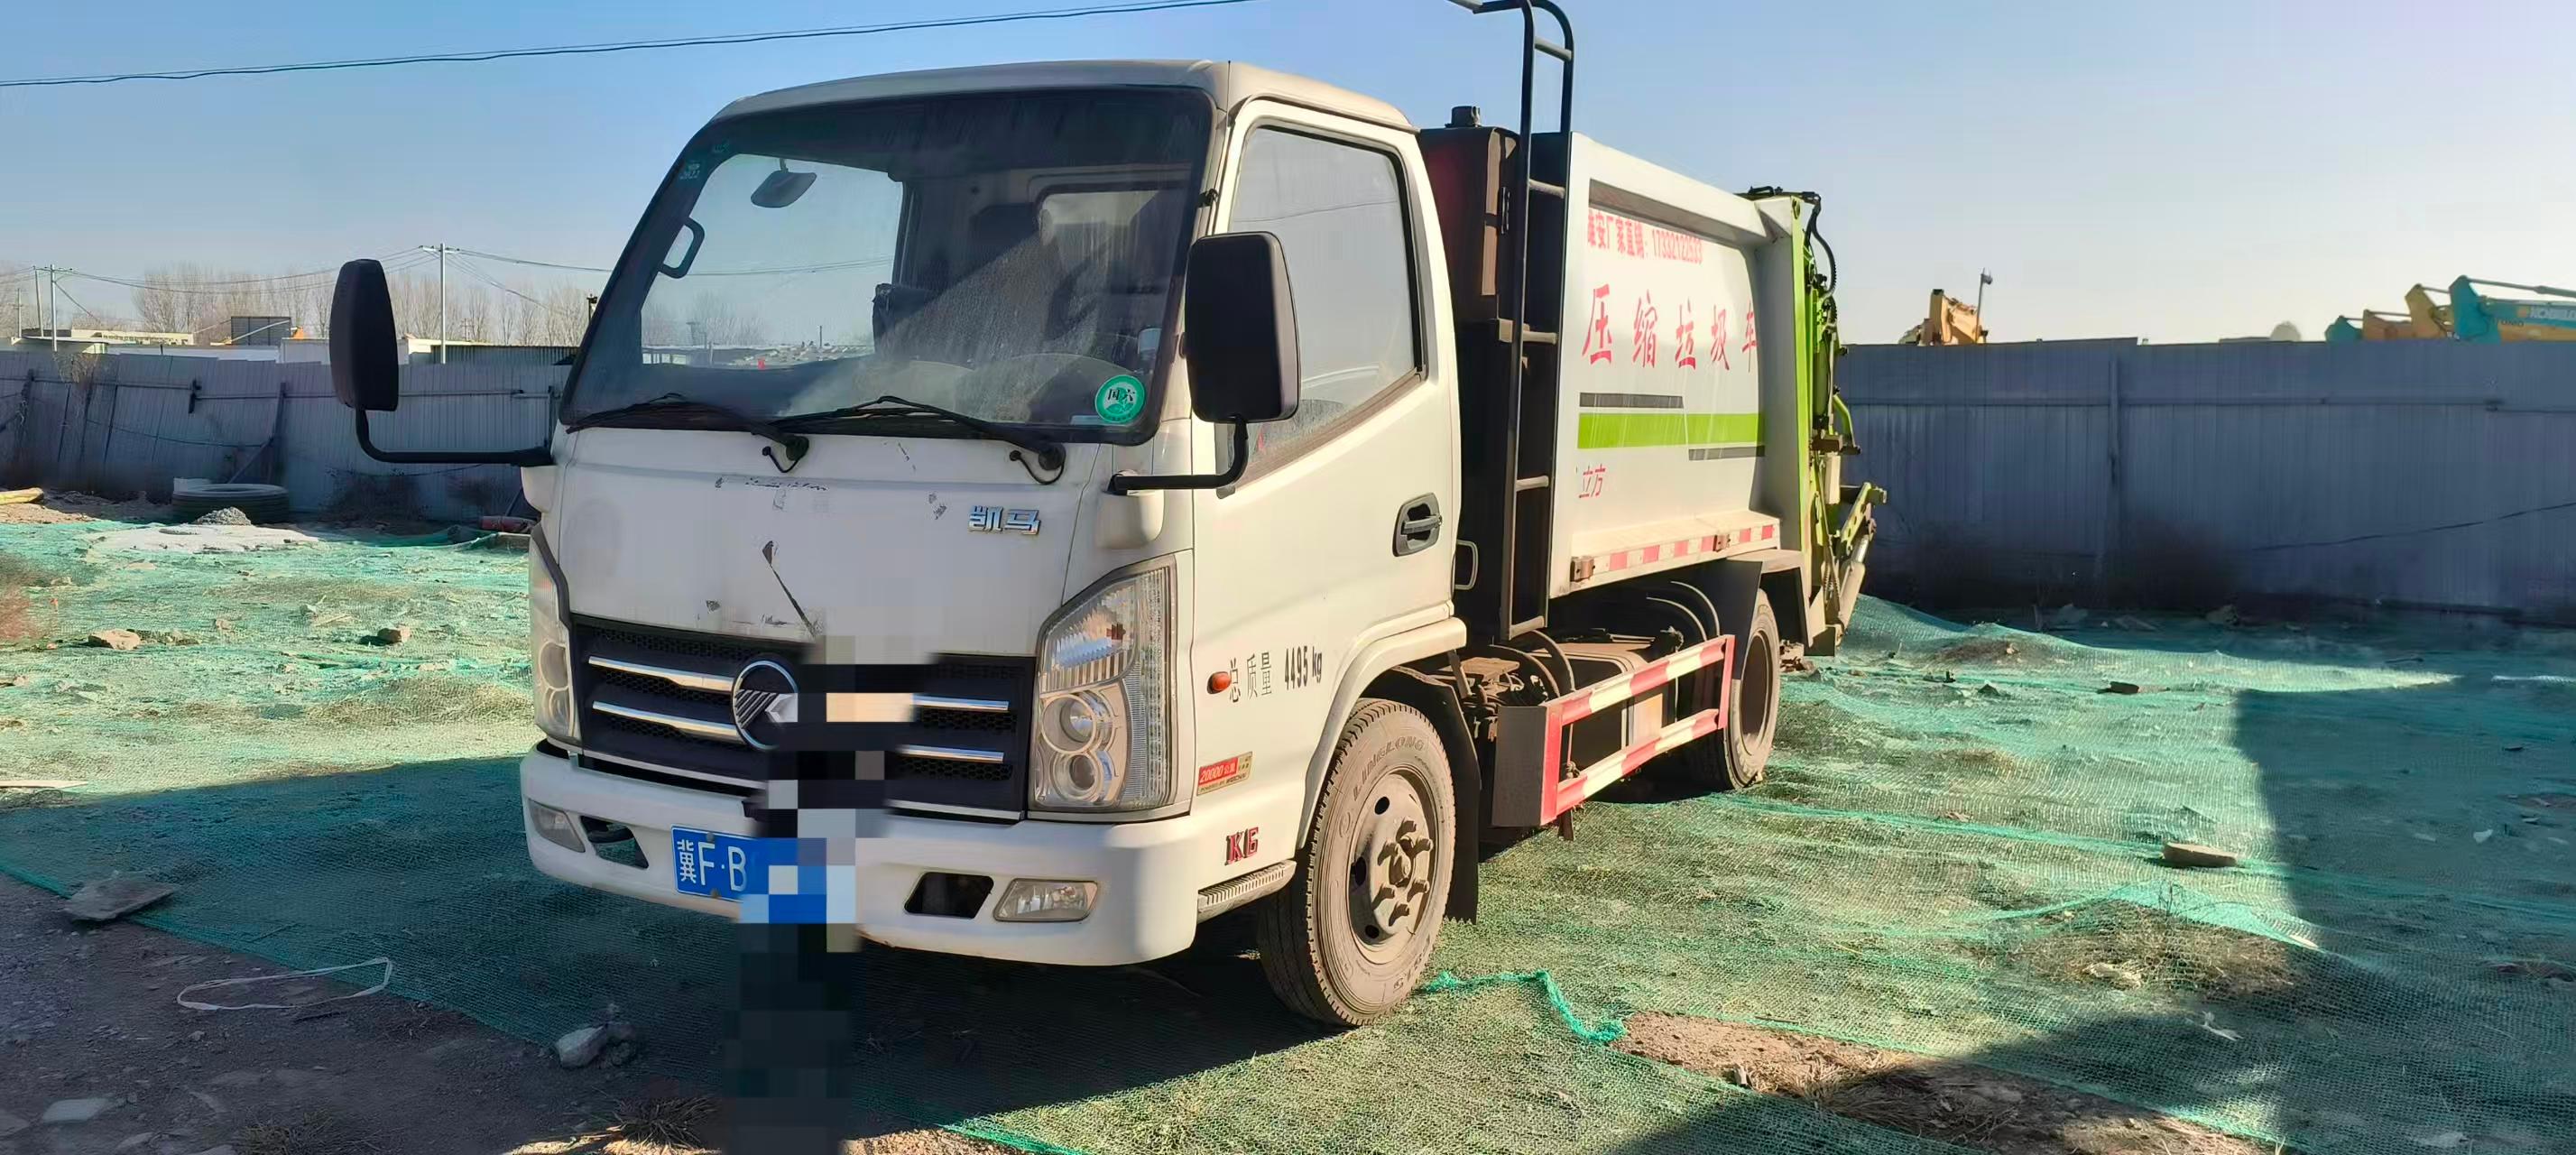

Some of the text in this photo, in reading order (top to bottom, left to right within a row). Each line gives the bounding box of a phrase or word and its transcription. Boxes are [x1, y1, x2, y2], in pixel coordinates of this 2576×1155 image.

[1582, 283, 1757, 373] 压缩垃圾车
[1107, 388, 1136, 402] 国六
[968, 504, 1041, 536] 凯马
[1228, 644, 1323, 703] 总质量 4495 kg
